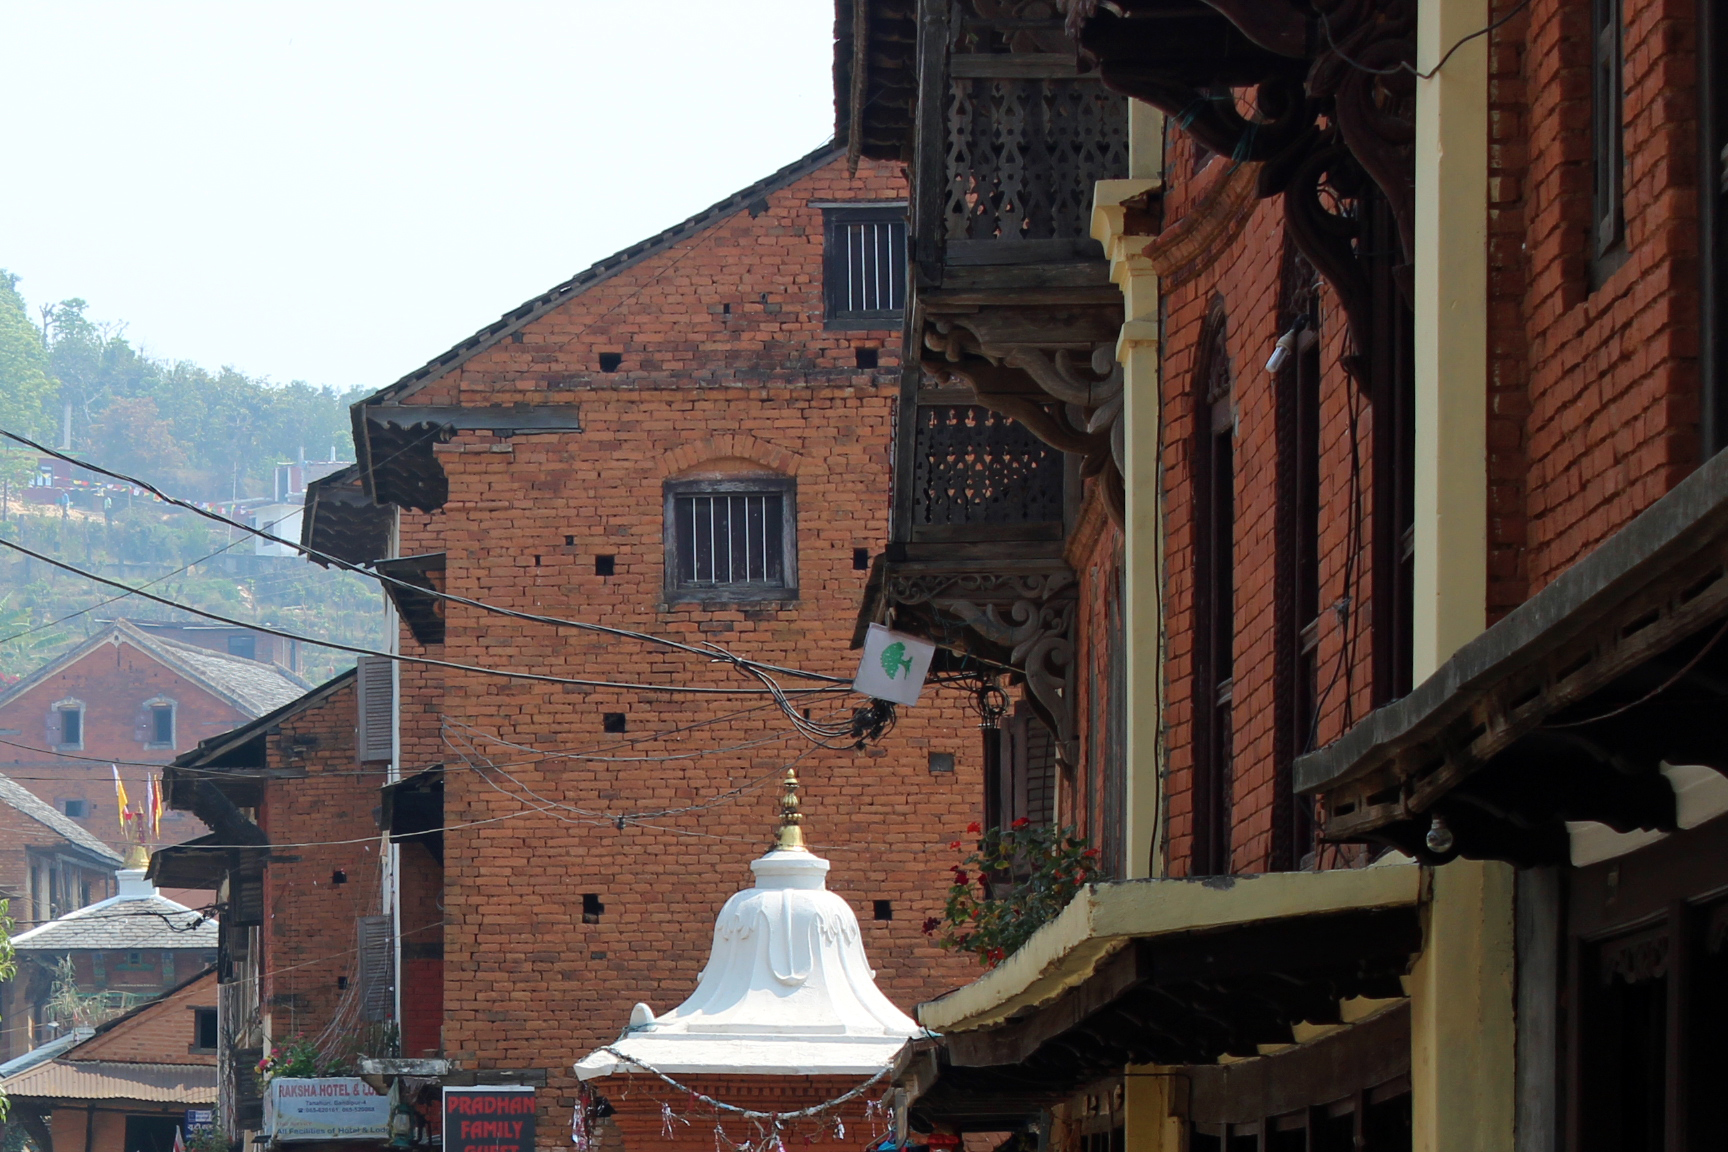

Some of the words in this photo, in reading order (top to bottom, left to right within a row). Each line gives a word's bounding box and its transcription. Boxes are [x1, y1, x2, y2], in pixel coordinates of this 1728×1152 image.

[278, 1084, 317, 1098] RAKSHA
[319, 1084, 350, 1097] HOTEL
[353, 1083, 360, 1096] &
[362, 1084, 380, 1096] LO
[447, 1096, 537, 1115] PRADHAN
[460, 1120, 524, 1139] FAMILY
